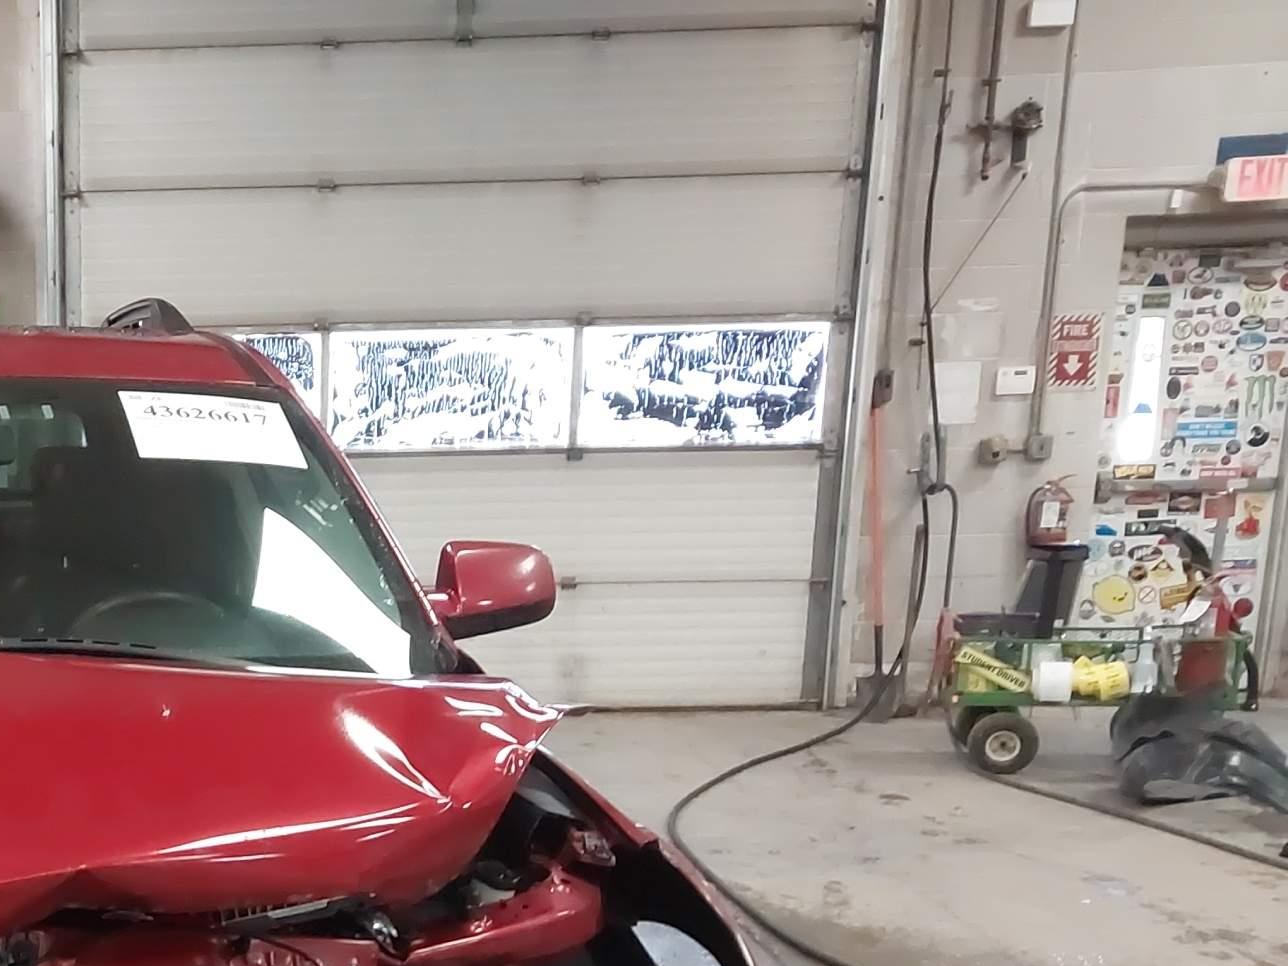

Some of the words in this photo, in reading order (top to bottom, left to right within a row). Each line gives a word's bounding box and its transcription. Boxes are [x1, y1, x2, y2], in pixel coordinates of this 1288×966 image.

[1239, 158, 1288, 196] EXIT
[1062, 323, 1090, 337] FIRE
[143, 404, 267, 426] 43626617
